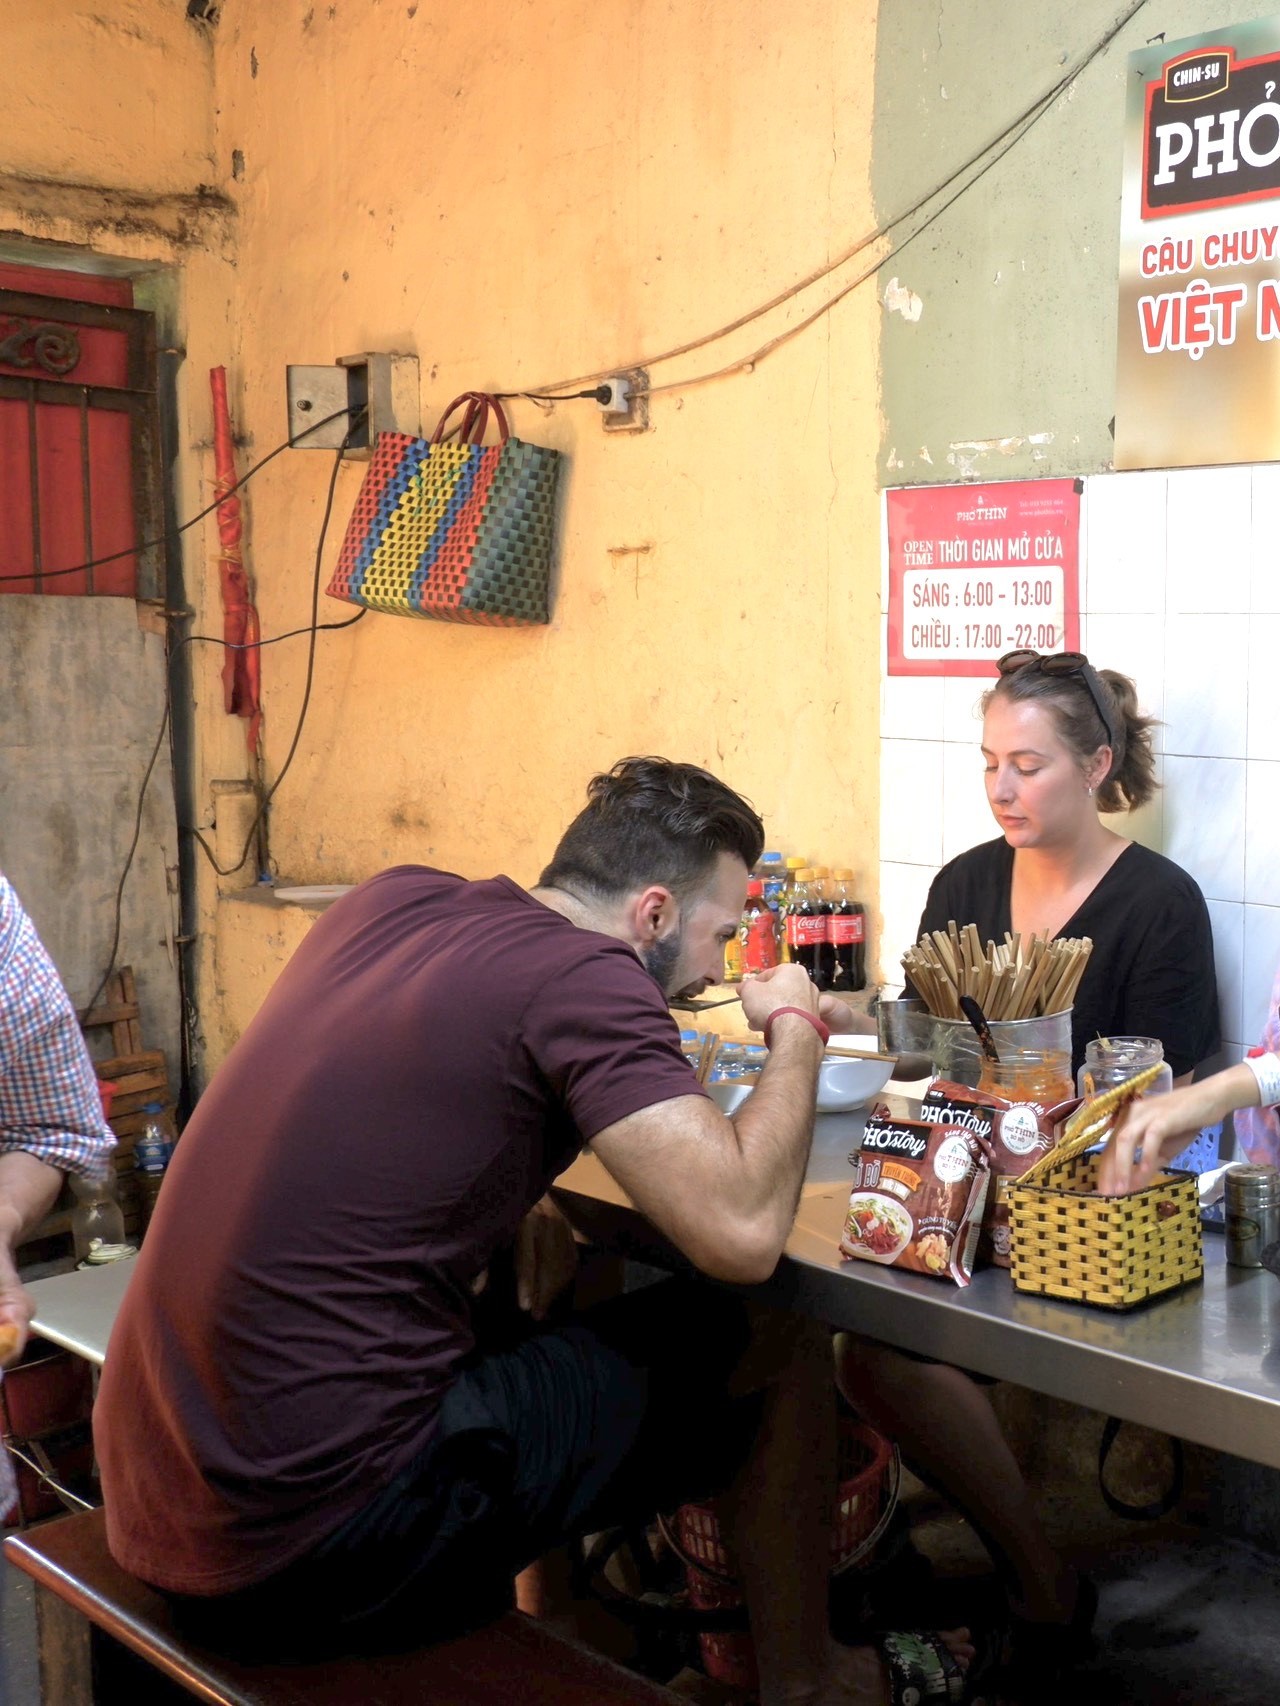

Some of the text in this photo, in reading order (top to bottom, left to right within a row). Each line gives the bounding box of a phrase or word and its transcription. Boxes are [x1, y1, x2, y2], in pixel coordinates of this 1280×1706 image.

[1173, 62, 1220, 88] CHIN-SU
[1141, 236, 1193, 276] CÂU
[1142, 284, 1243, 356] VIỆT
[976, 504, 1008, 521] THÌN
[903, 540, 934, 552] OPEN
[903, 553, 934, 566] TIME
[938, 530, 1063, 563] THỜI GIAN MỞ CỬA
[913, 578, 950, 608] SÁNG
[963, 582, 993, 607] 6:00
[1013, 580, 1052, 607] 13:00
[912, 617, 951, 649] CHIỀU
[964, 624, 1002, 649] 17:00
